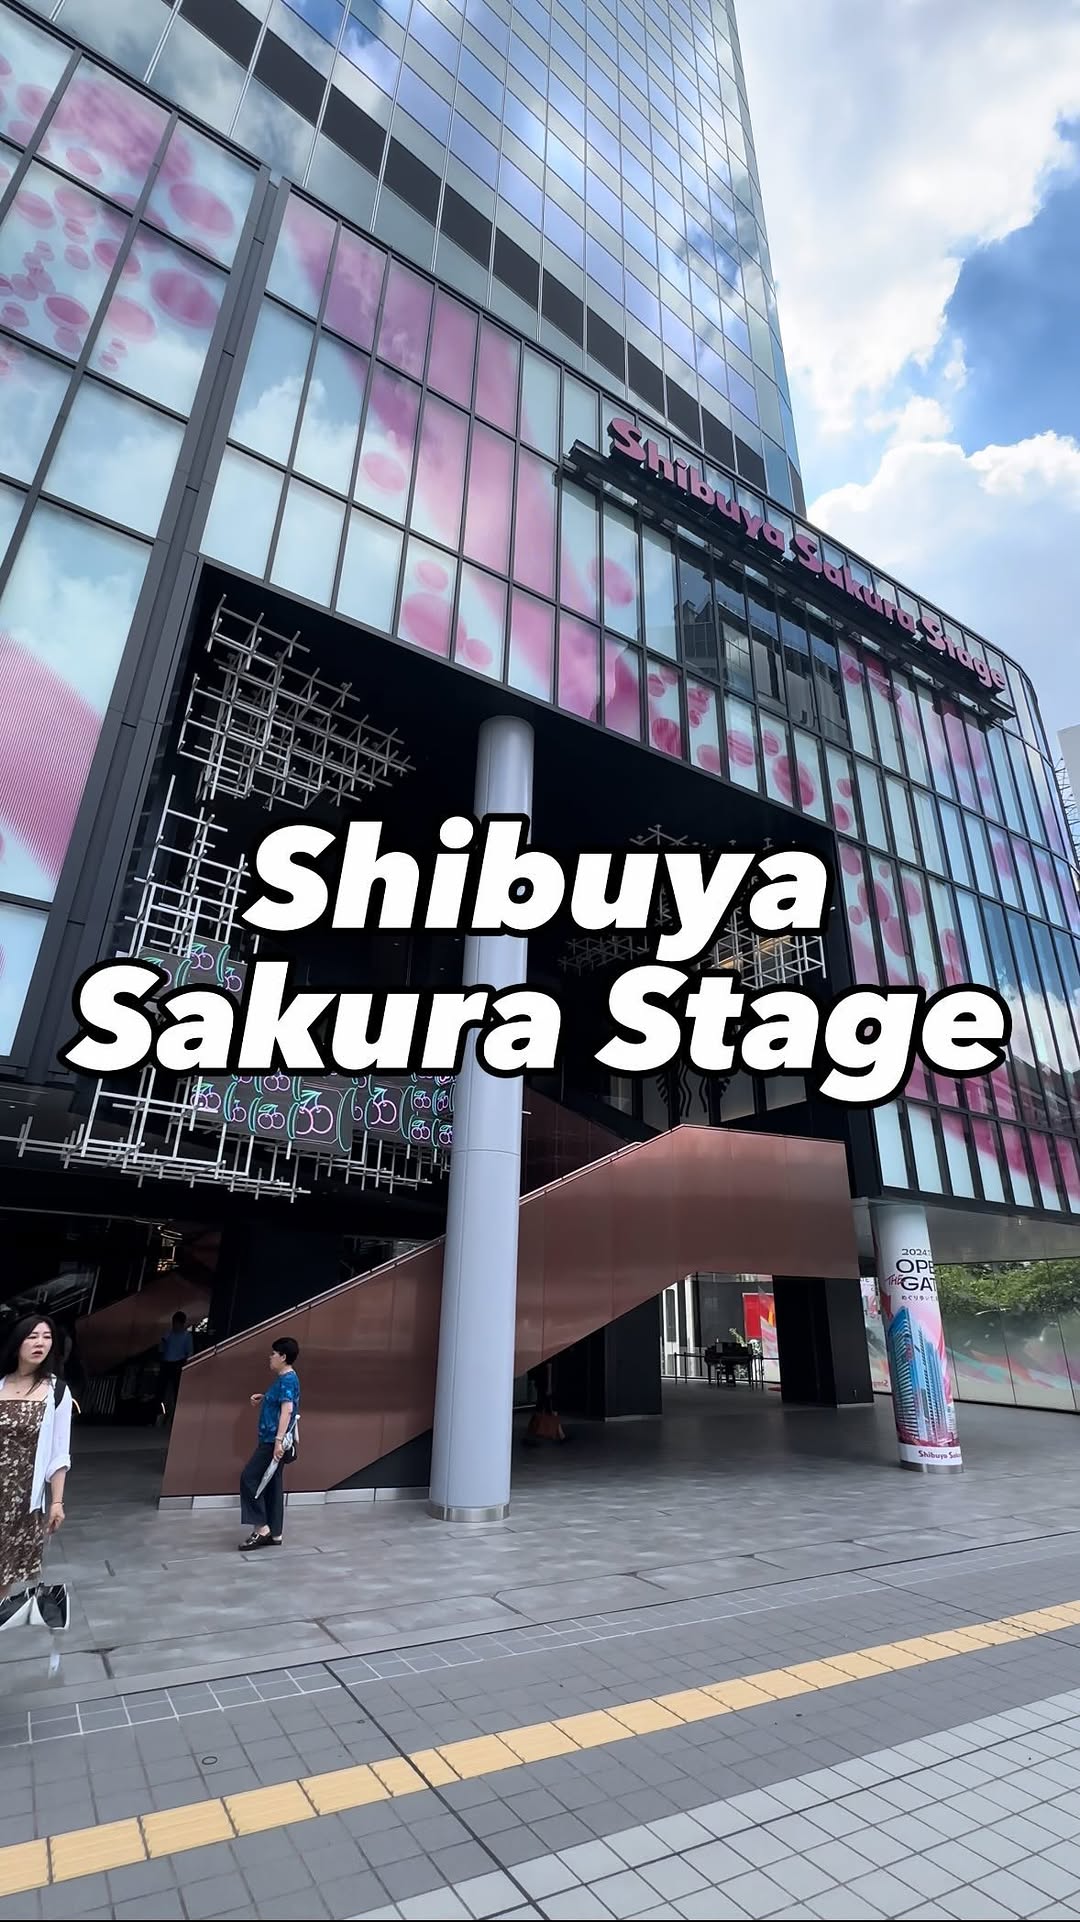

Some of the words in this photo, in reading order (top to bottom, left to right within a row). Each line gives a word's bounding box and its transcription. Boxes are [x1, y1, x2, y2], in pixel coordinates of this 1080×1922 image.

[608, 417, 785, 552] Shibuya
[790, 533, 915, 634] Sakura
[918, 615, 1007, 690] Stage
